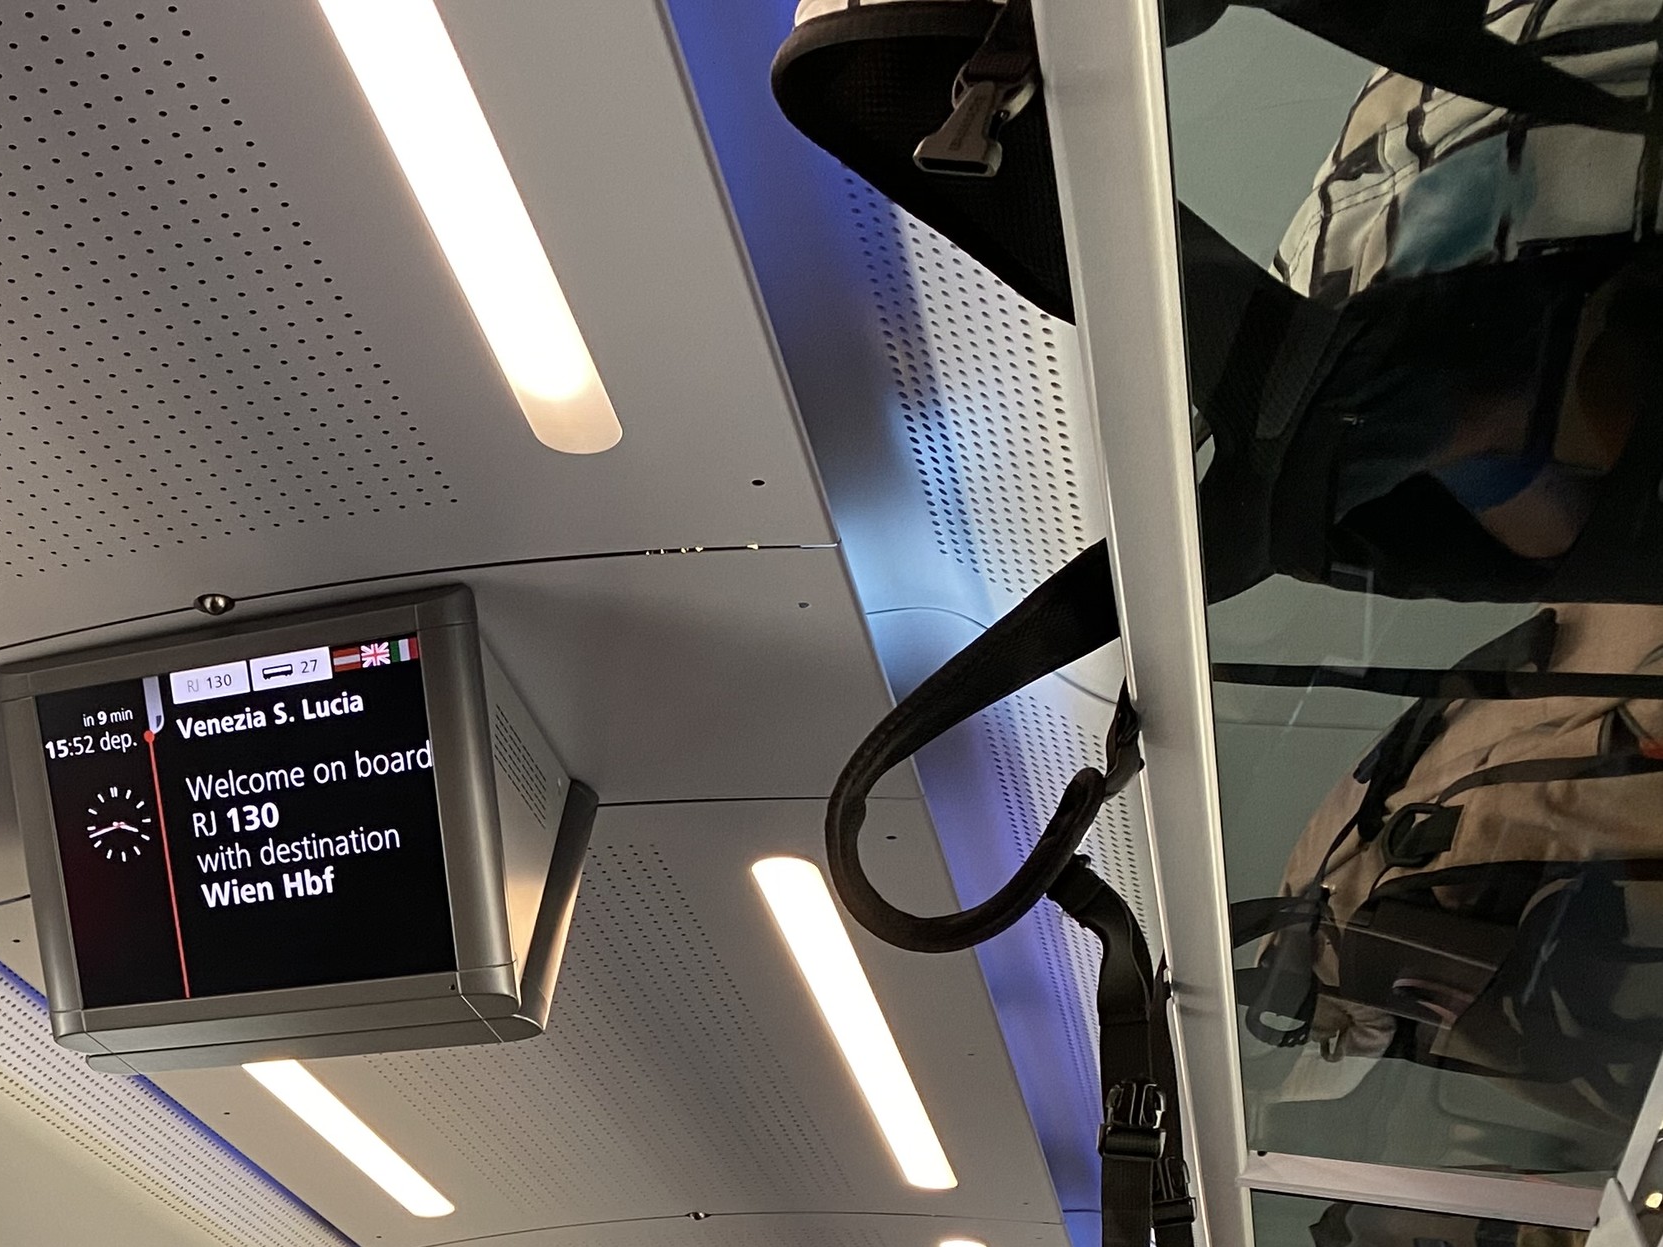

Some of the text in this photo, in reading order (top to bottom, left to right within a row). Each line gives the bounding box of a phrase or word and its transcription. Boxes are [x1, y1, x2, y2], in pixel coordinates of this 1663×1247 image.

[187, 674, 232, 692] RJ 130
[301, 660, 318, 674] 27
[82, 706, 133, 727] in 9 min
[176, 691, 364, 739] Venezia S. Lucia
[45, 729, 138, 760] 15:52 dep.
[185, 740, 434, 802] Welcome on board
[192, 801, 280, 841] RJ 130
[197, 826, 401, 874] with destination
[201, 866, 336, 908] Wien Hbf
